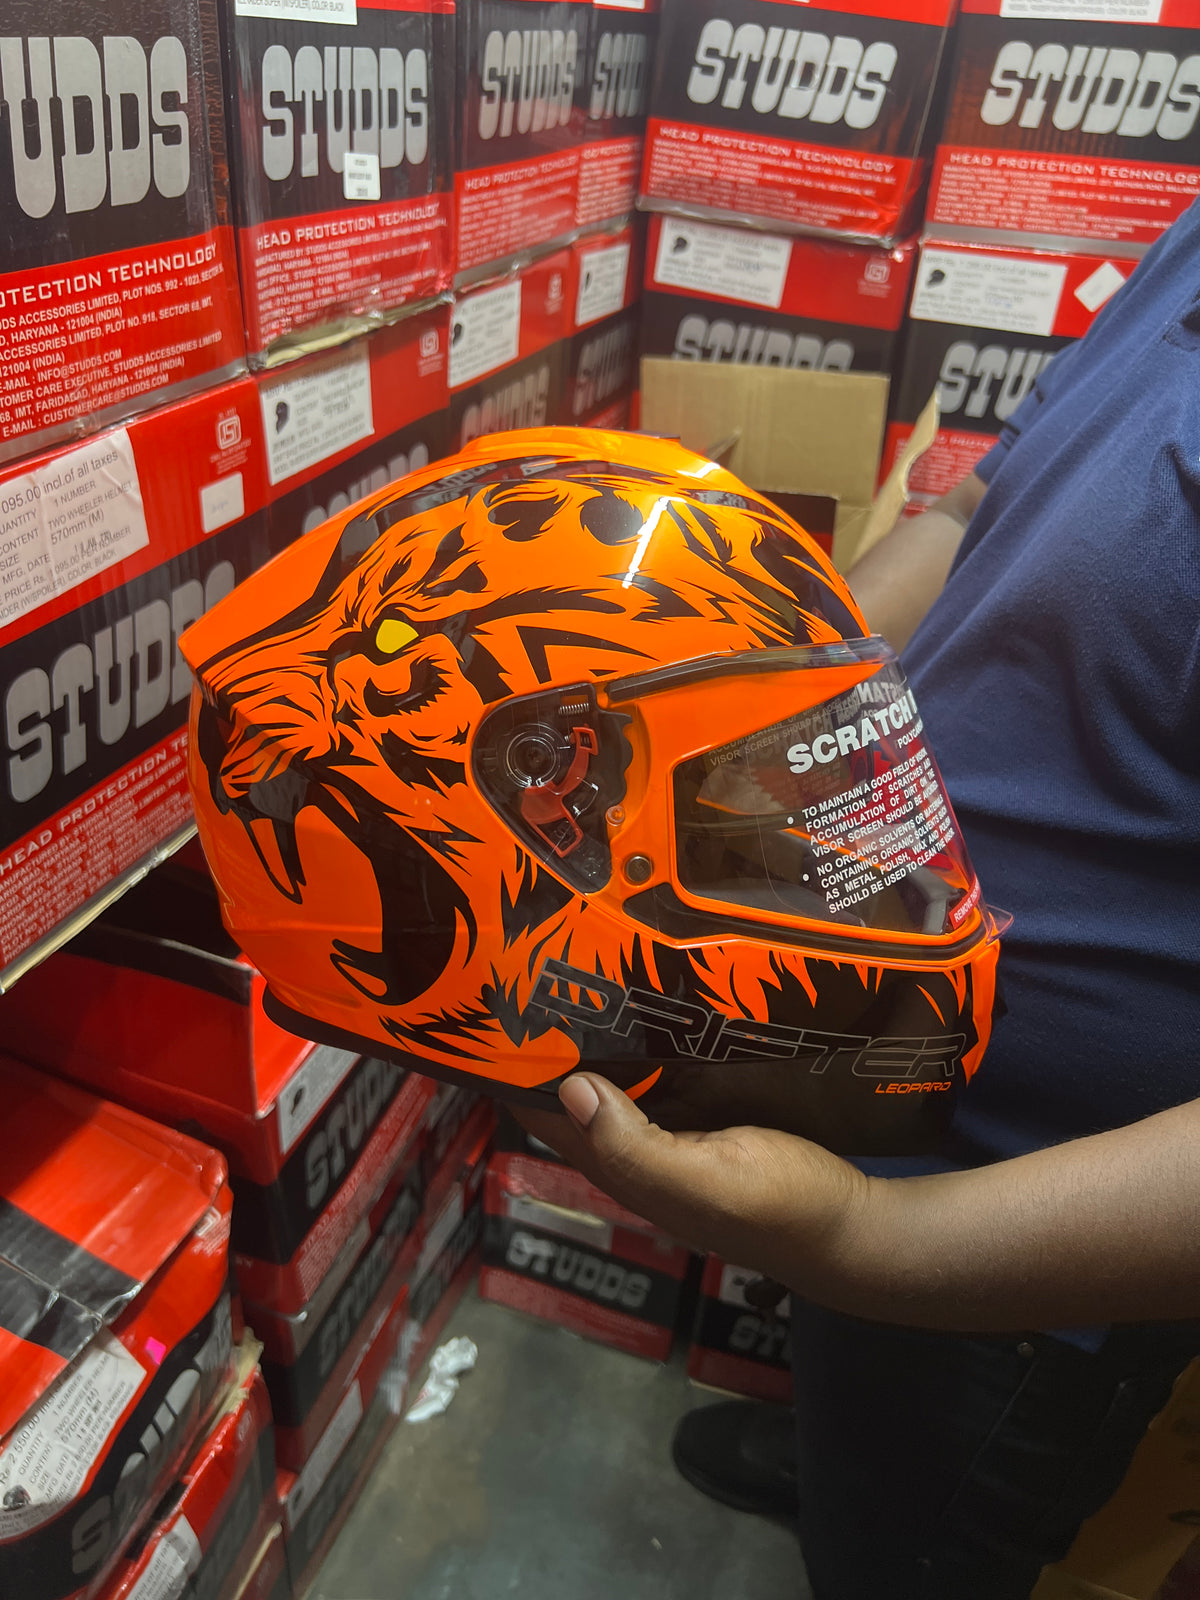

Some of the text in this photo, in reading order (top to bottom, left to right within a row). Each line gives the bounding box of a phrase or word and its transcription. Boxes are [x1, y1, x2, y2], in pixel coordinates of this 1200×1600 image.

[479, 30, 577, 140] STUDDS
[687, 18, 897, 129] STUDDS
[981, 40, 1200, 140] STUDDS
[262, 44, 428, 181] STUDDS
[702, 133, 791, 157] PROTECTION
[794, 149, 895, 173] TECHNOLOGY
[950, 153, 993, 167] HEAD
[997, 157, 1094, 175] PROTECTION
[107, 242, 217, 283] TECHNOLOGY
[257, 230, 291, 251] HEAD
[296, 216, 376, 243] PROTECTION
[0, 336, 67, 362] ACCESSORIES
[69, 326, 104, 346] LIMITED,
[106, 320, 125, 335] PLOT
[127, 315, 142, 329] NO.
[159, 302, 190, 320] SECTOR
[11, 322, 59, 343] HARYANA
[67, 314, 94, 331] 121004
[96, 306, 122, 324] (INDIA)
[19, 301, 86, 327] ACCESSORIES
[87, 292, 122, 311] LIMITED,
[123, 286, 143, 302] PLOT
[145, 282, 164, 296] NOS.
[165, 278, 178, 291] 992
[33, 351, 65, 371] (INDIA)
[36, 382, 63, 398] CARE
[64, 367, 113, 390] EXECUTIVE,
[114, 355, 144, 374] STUDDS
[145, 340, 198, 363] ACCESSORIES
[199, 330, 223, 348] LIMITED
[37, 349, 122, 383] INFO@STUDDS.COM
[91, 374, 129, 394] HARYANA
[160, 355, 185, 374] (INDIA)
[938, 341, 1056, 421] STU
[3, 419, 36, 438] E-MAIL
[60, 480, 97, 506] NUMBER
[77, 462, 89, 478] all
[91, 451, 119, 469] taxes
[0, 553, 19, 570] SIZE
[50, 521, 87, 545] 570mm
[88, 508, 104, 527] (M)
[48, 514, 66, 531] TWO
[68, 499, 102, 519] WHEELER
[2, 553, 50, 586] MFG. DATE
[4, 578, 34, 600] PRICE
[787, 695, 913, 774] SCRATCH
[0, 829, 52, 876] HEAD
[60, 748, 167, 833] PROTECTION
[802, 806, 818, 819] TO
[819, 785, 863, 813] MAINTAIN
[864, 783, 871, 793] A
[871, 771, 893, 789] GOOD
[892, 761, 909, 778] FIELD
[908, 756, 916, 768] OF
[805, 798, 867, 833] FORMATION
[871, 790, 884, 803] OF
[888, 765, 923, 794] SCRATCHES
[810, 803, 886, 846] ACCUMULATION
[889, 794, 900, 807] OF
[903, 783, 918, 799] DIRT
[812, 837, 846, 858] VISOR
[847, 818, 885, 843] SCREEN
[885, 800, 914, 824] SHOULD
[913, 793, 923, 807] BE
[816, 862, 833, 877] NO
[835, 841, 878, 868] ORGANIC
[878, 818, 916, 847] SOLVENTS
[915, 812, 925, 825] OR
[821, 854, 879, 889] CONTAINING
[880, 834, 914, 860] ORGANIC
[914, 814, 940, 840] SOLVENTS
[825, 887, 840, 902] AS
[844, 871, 877, 893] METAL
[879, 851, 911, 876] POLISH,
[912, 841, 928, 856] WAX
[928, 829, 940, 841] AND
[828, 839, 947, 914] SHOULD BE USED TO CLEAN THE
[528, 957, 966, 1078] DRIFTER
[875, 1082, 952, 1094] LEOPARD
[505, 1231, 653, 1308] STUDDS
